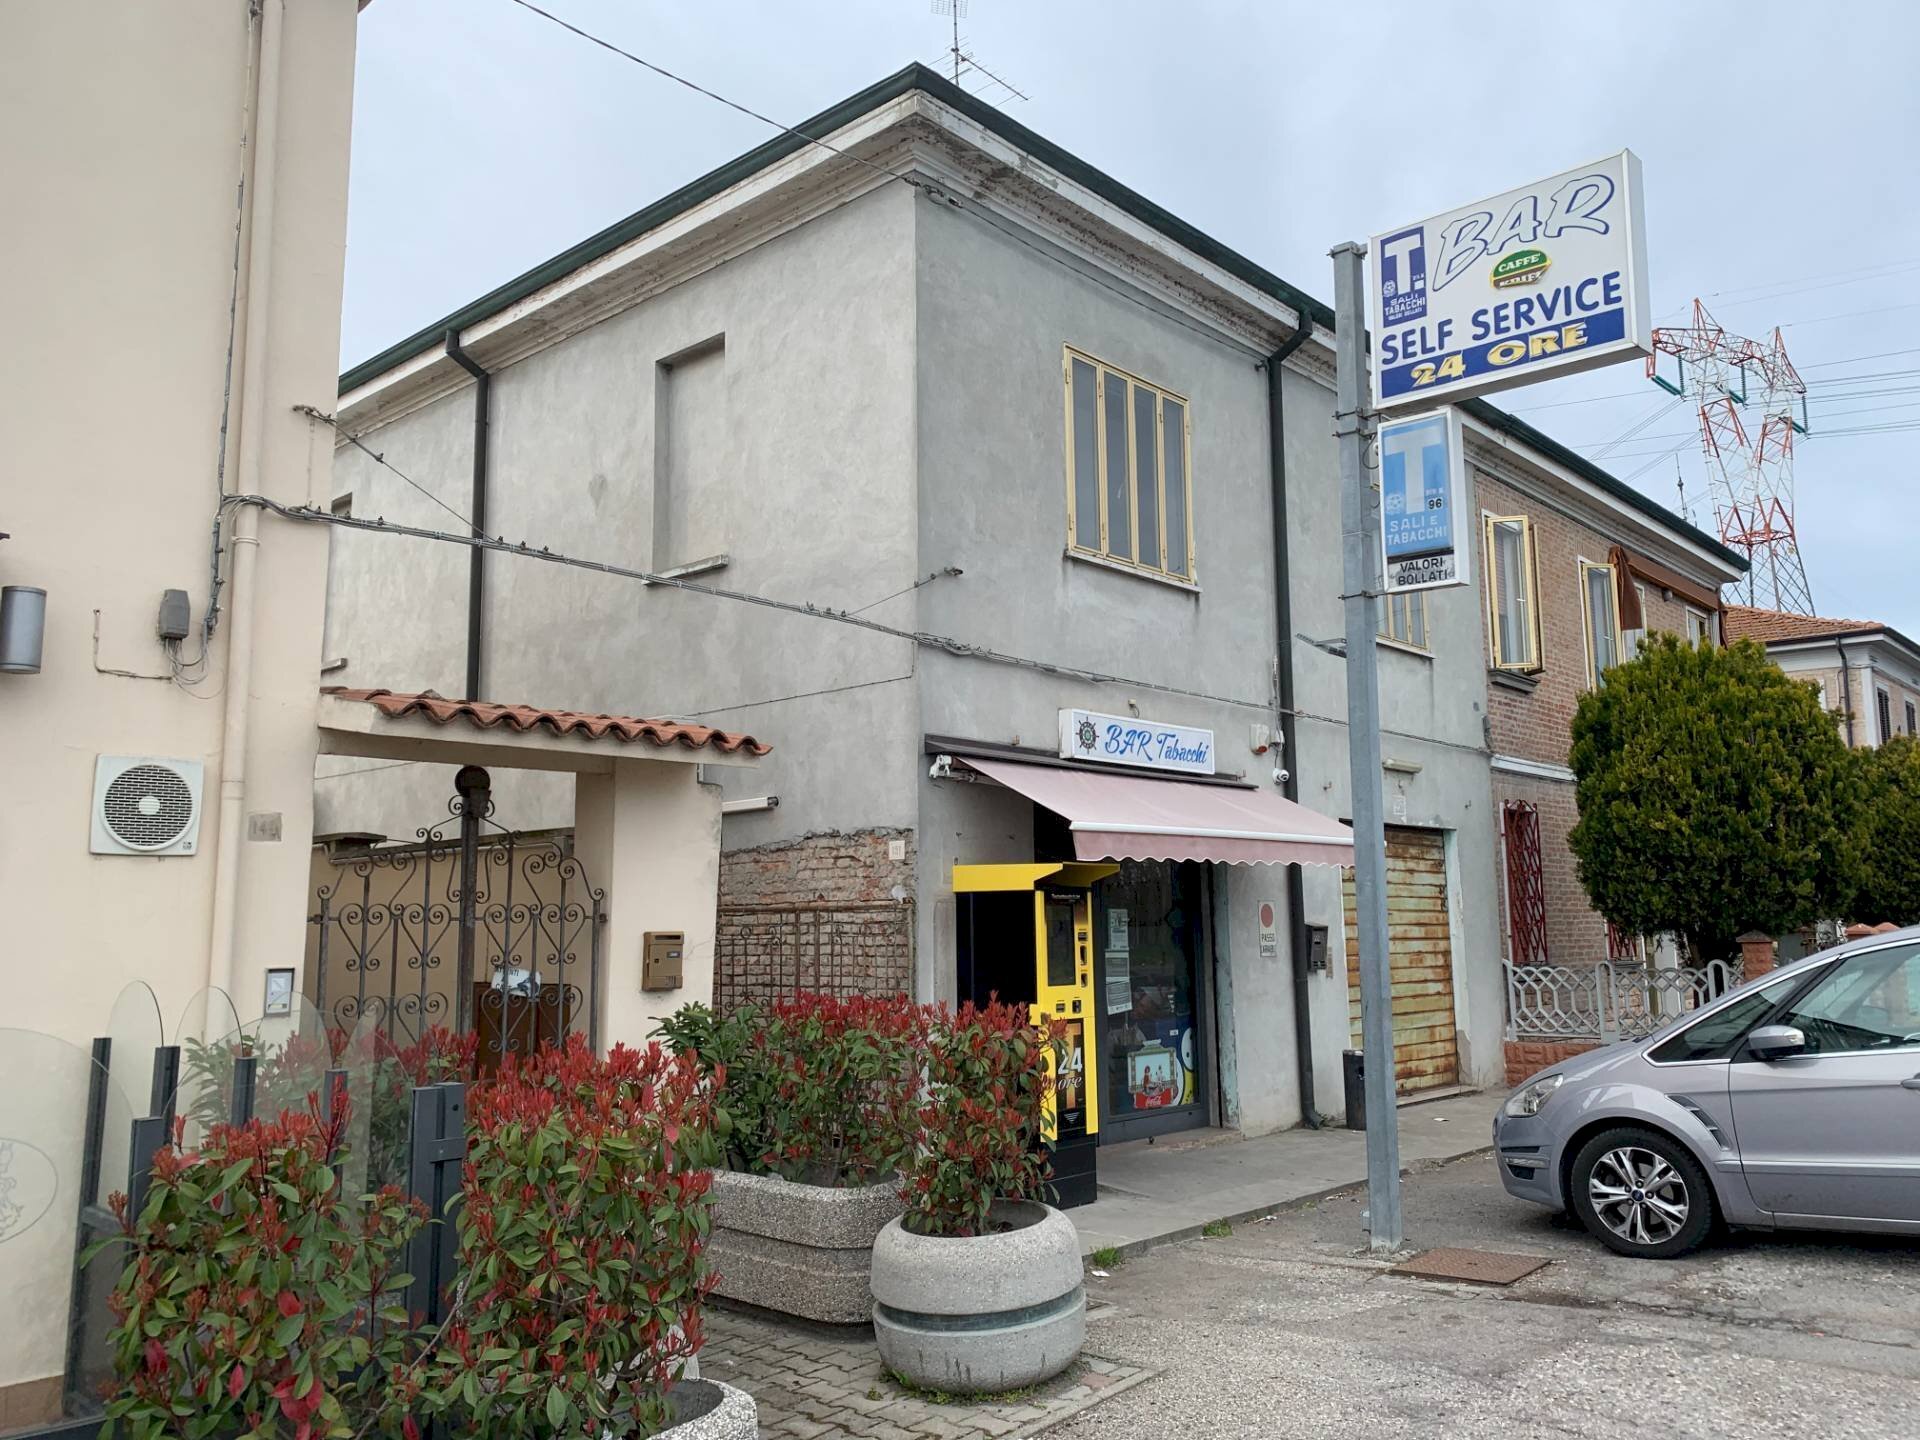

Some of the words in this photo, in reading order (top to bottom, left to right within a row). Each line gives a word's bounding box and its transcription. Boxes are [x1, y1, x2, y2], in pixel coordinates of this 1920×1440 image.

[1432, 174, 1615, 292] BAR
[1384, 233, 1421, 295] T
[1384, 297, 1426, 316] TABACCHI
[1390, 292, 1414, 306] SALI
[1380, 318, 1453, 366] SELF
[1471, 271, 1623, 341] SERVICE
[1410, 351, 1466, 389] 24
[1487, 322, 1588, 366] ORE
[1384, 425, 1442, 515] T
[1427, 498, 1442, 510] 96
[1390, 515, 1425, 532] SALI
[1430, 515, 1438, 525] E
[1387, 525, 1448, 545] TABACCHI
[1400, 557, 1443, 573] VALORI
[1397, 570, 1448, 586] BOLLATI
[1104, 724, 1153, 761] BAR
[1156, 732, 1210, 764] Tabacchi
[1057, 1047, 1083, 1075] 24
[1058, 1076, 1083, 1091] ore
